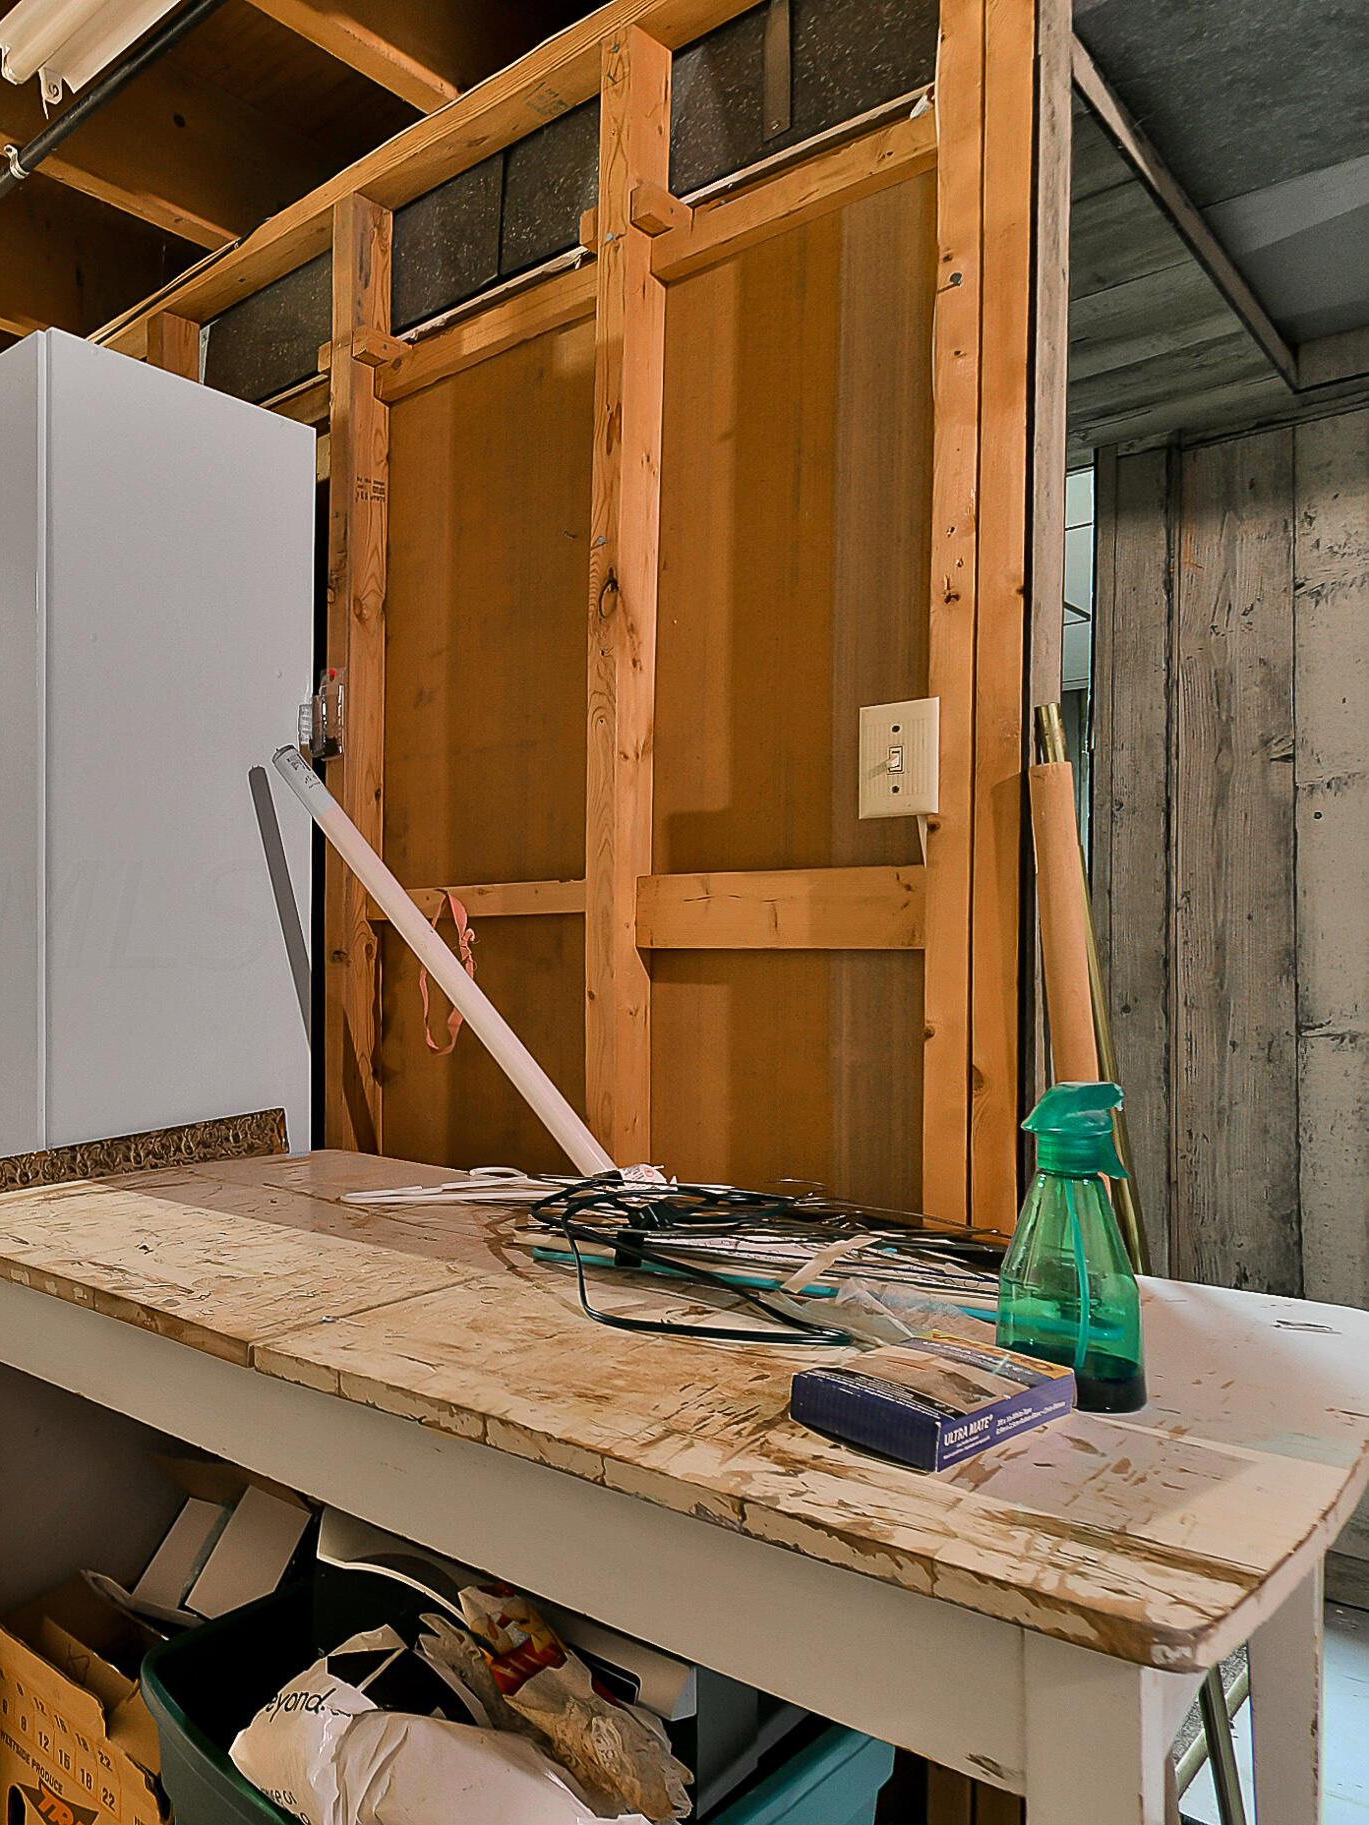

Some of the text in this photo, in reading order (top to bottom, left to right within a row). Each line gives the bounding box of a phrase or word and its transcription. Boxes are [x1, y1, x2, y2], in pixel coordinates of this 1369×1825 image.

[944, 1426, 968, 1446] ULTRA
[31, 1757, 64, 1795] PRODUCE
[39, 1732, 50, 1752] 12
[80, 1768, 93, 1790] 18
[102, 1787, 116, 1812] 22
